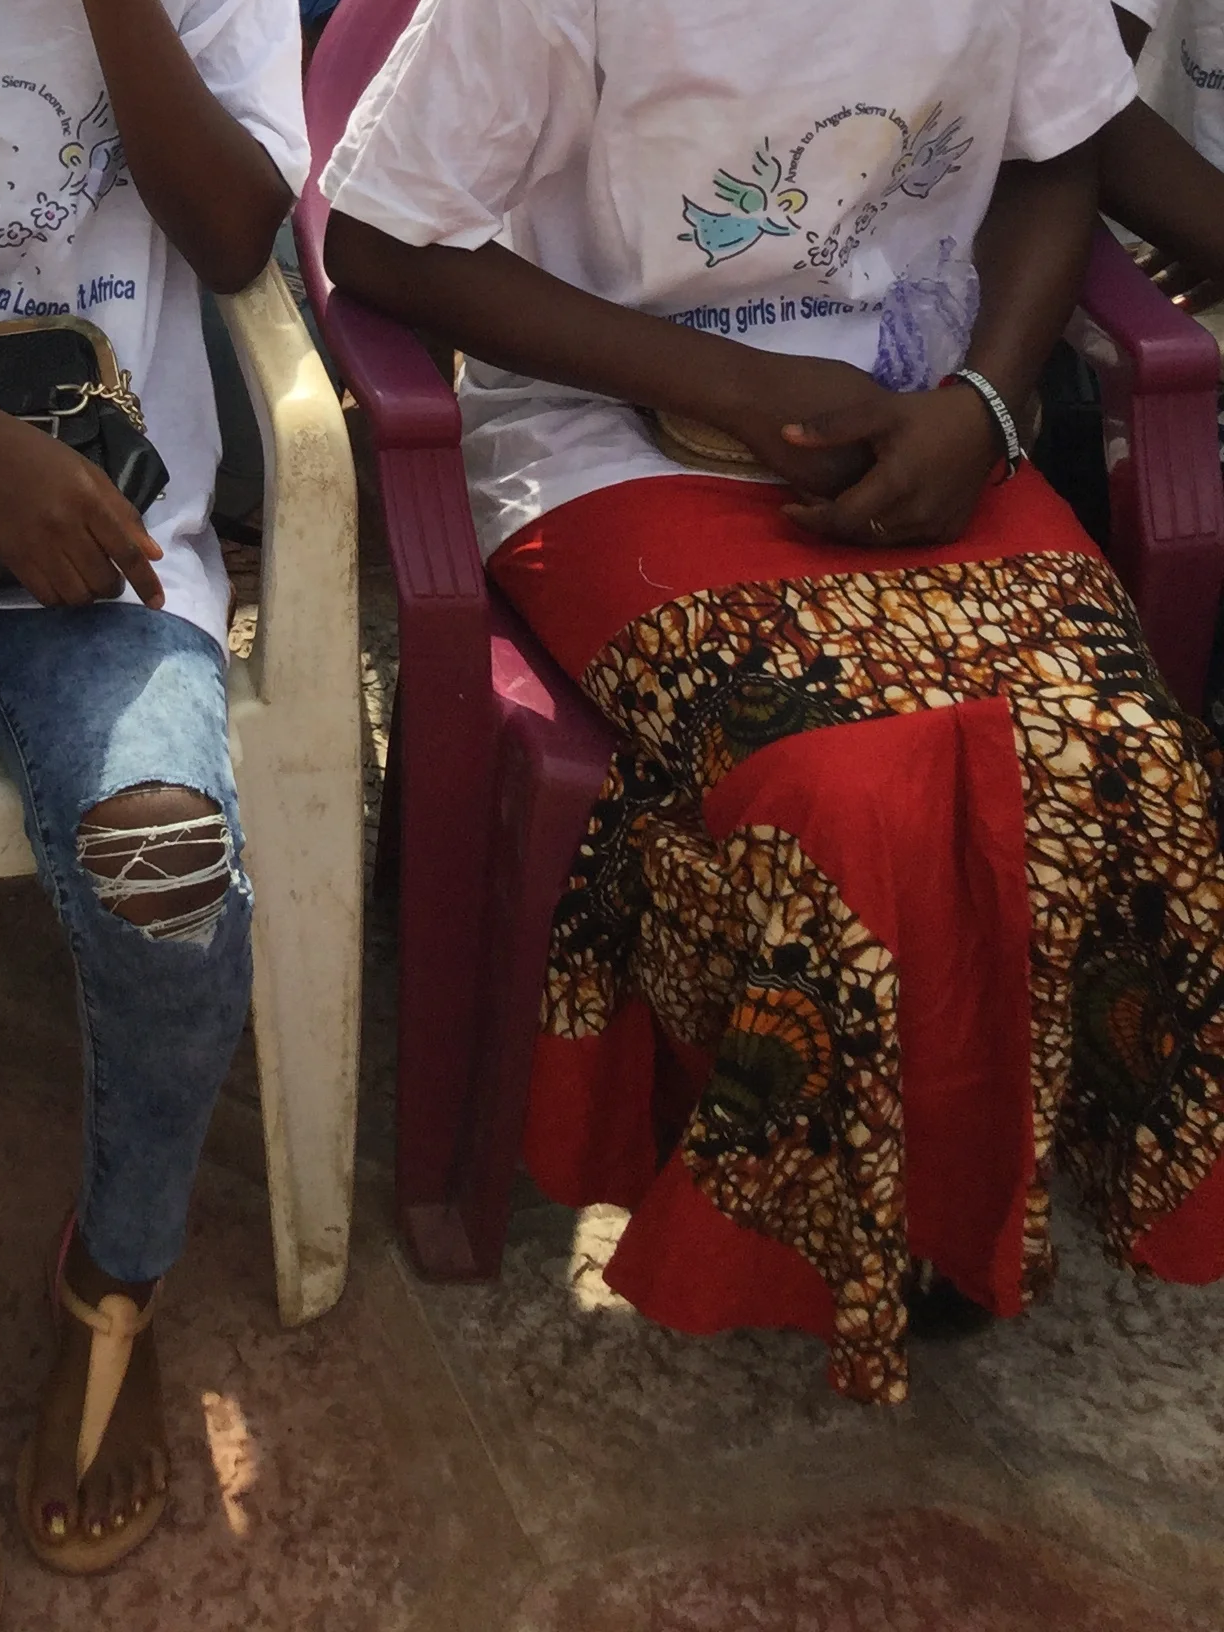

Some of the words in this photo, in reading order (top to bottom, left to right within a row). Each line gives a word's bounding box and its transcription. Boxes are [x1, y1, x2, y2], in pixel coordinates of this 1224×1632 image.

[1, 75, 37, 92] Sierra
[38, 84, 66, 117] Leone
[61, 117, 73, 137] Inc
[801, 132, 814, 145] to
[814, 105, 853, 133] Angels
[855, 102, 887, 117] Sierra
[89, 274, 136, 308] Africa
[735, 297, 776, 333] girls
[780, 295, 797, 322] in
[800, 295, 855, 320] Sierra
[989, 396, 1020, 460] MANCHESTER
